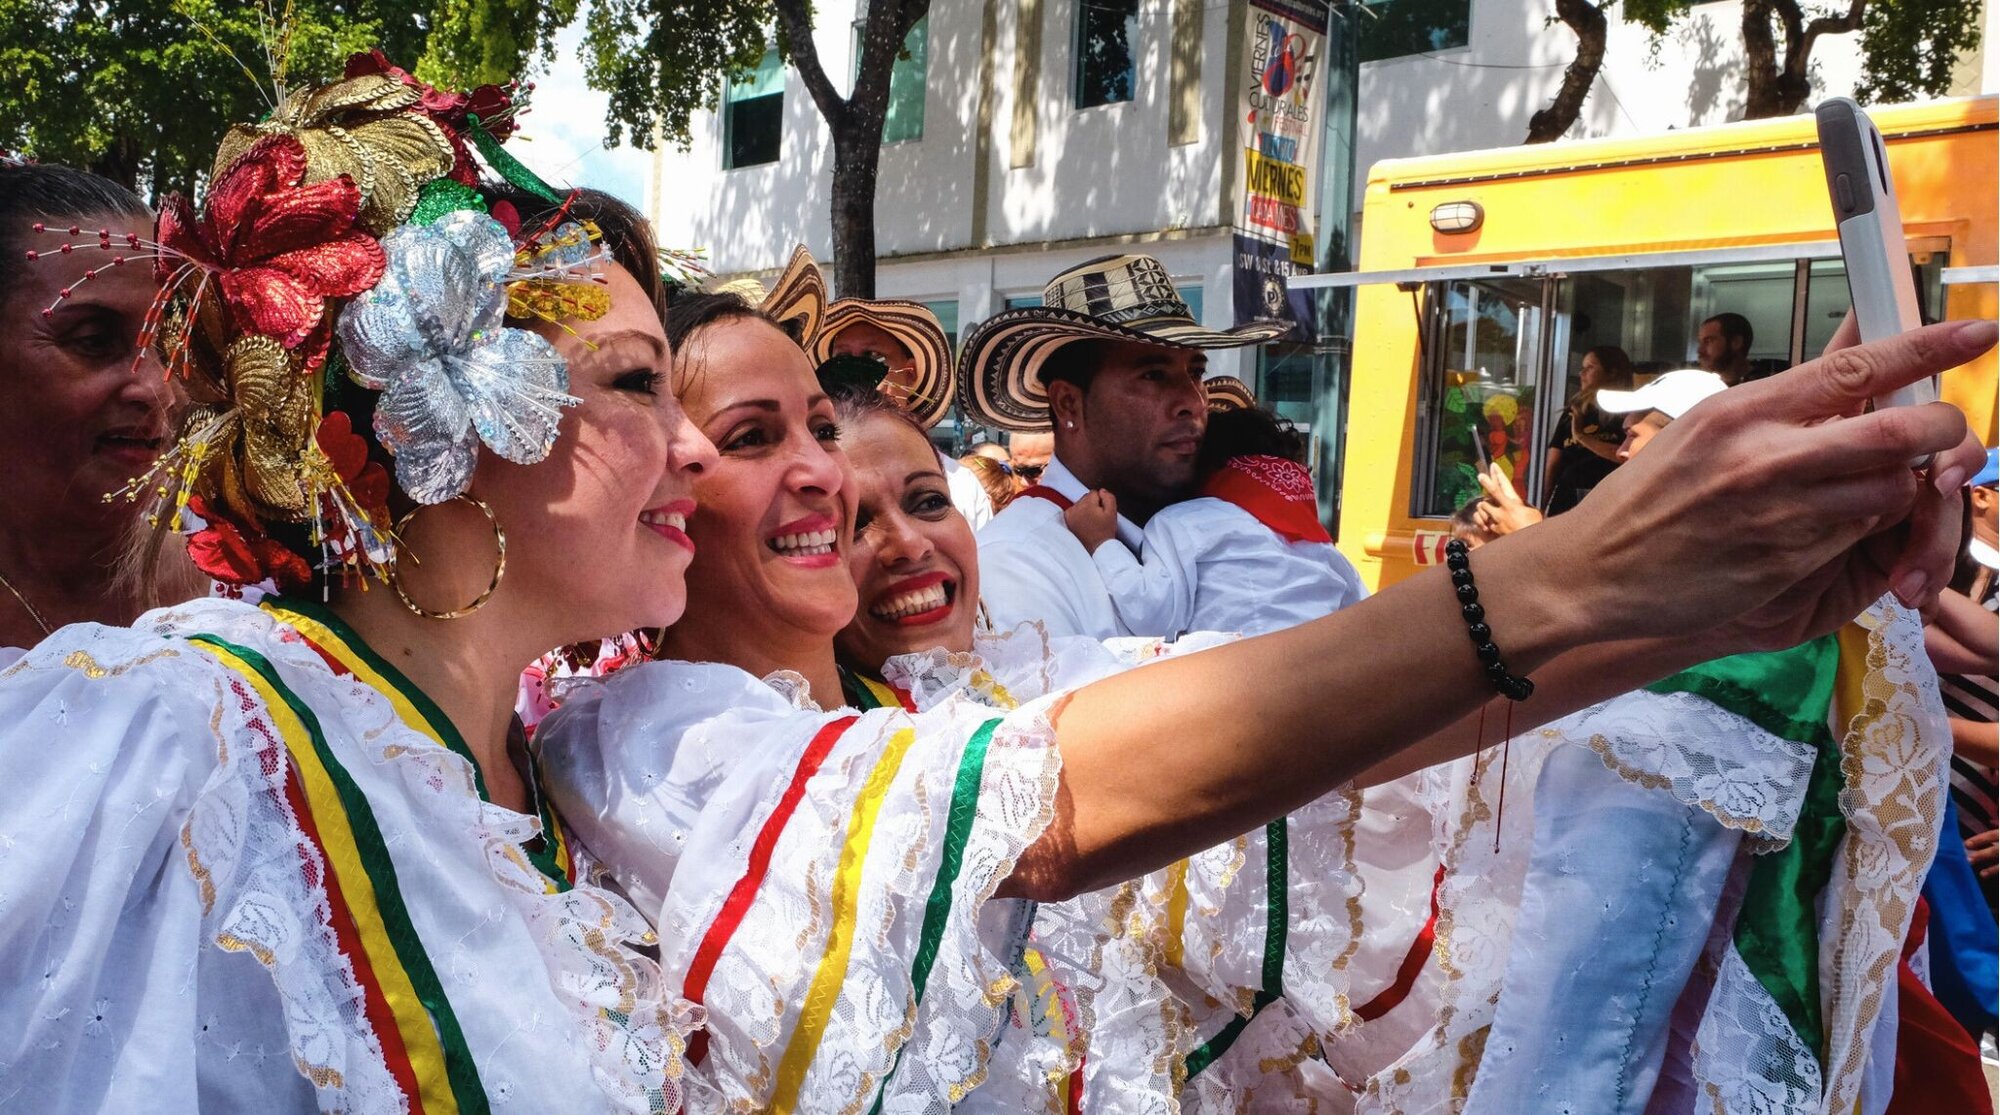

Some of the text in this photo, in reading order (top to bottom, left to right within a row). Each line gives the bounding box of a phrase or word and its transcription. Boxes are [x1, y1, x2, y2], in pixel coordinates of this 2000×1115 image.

[1249, 13, 1271, 89] VIERNES
[1249, 91, 1309, 122] CULTURALES
[1248, 158, 1303, 201] VIERNES
[1275, 203, 1297, 231] MES
[1239, 253, 1254, 270] SW
[1273, 259, 1281, 275] &
[1281, 260, 1290, 277] 15
